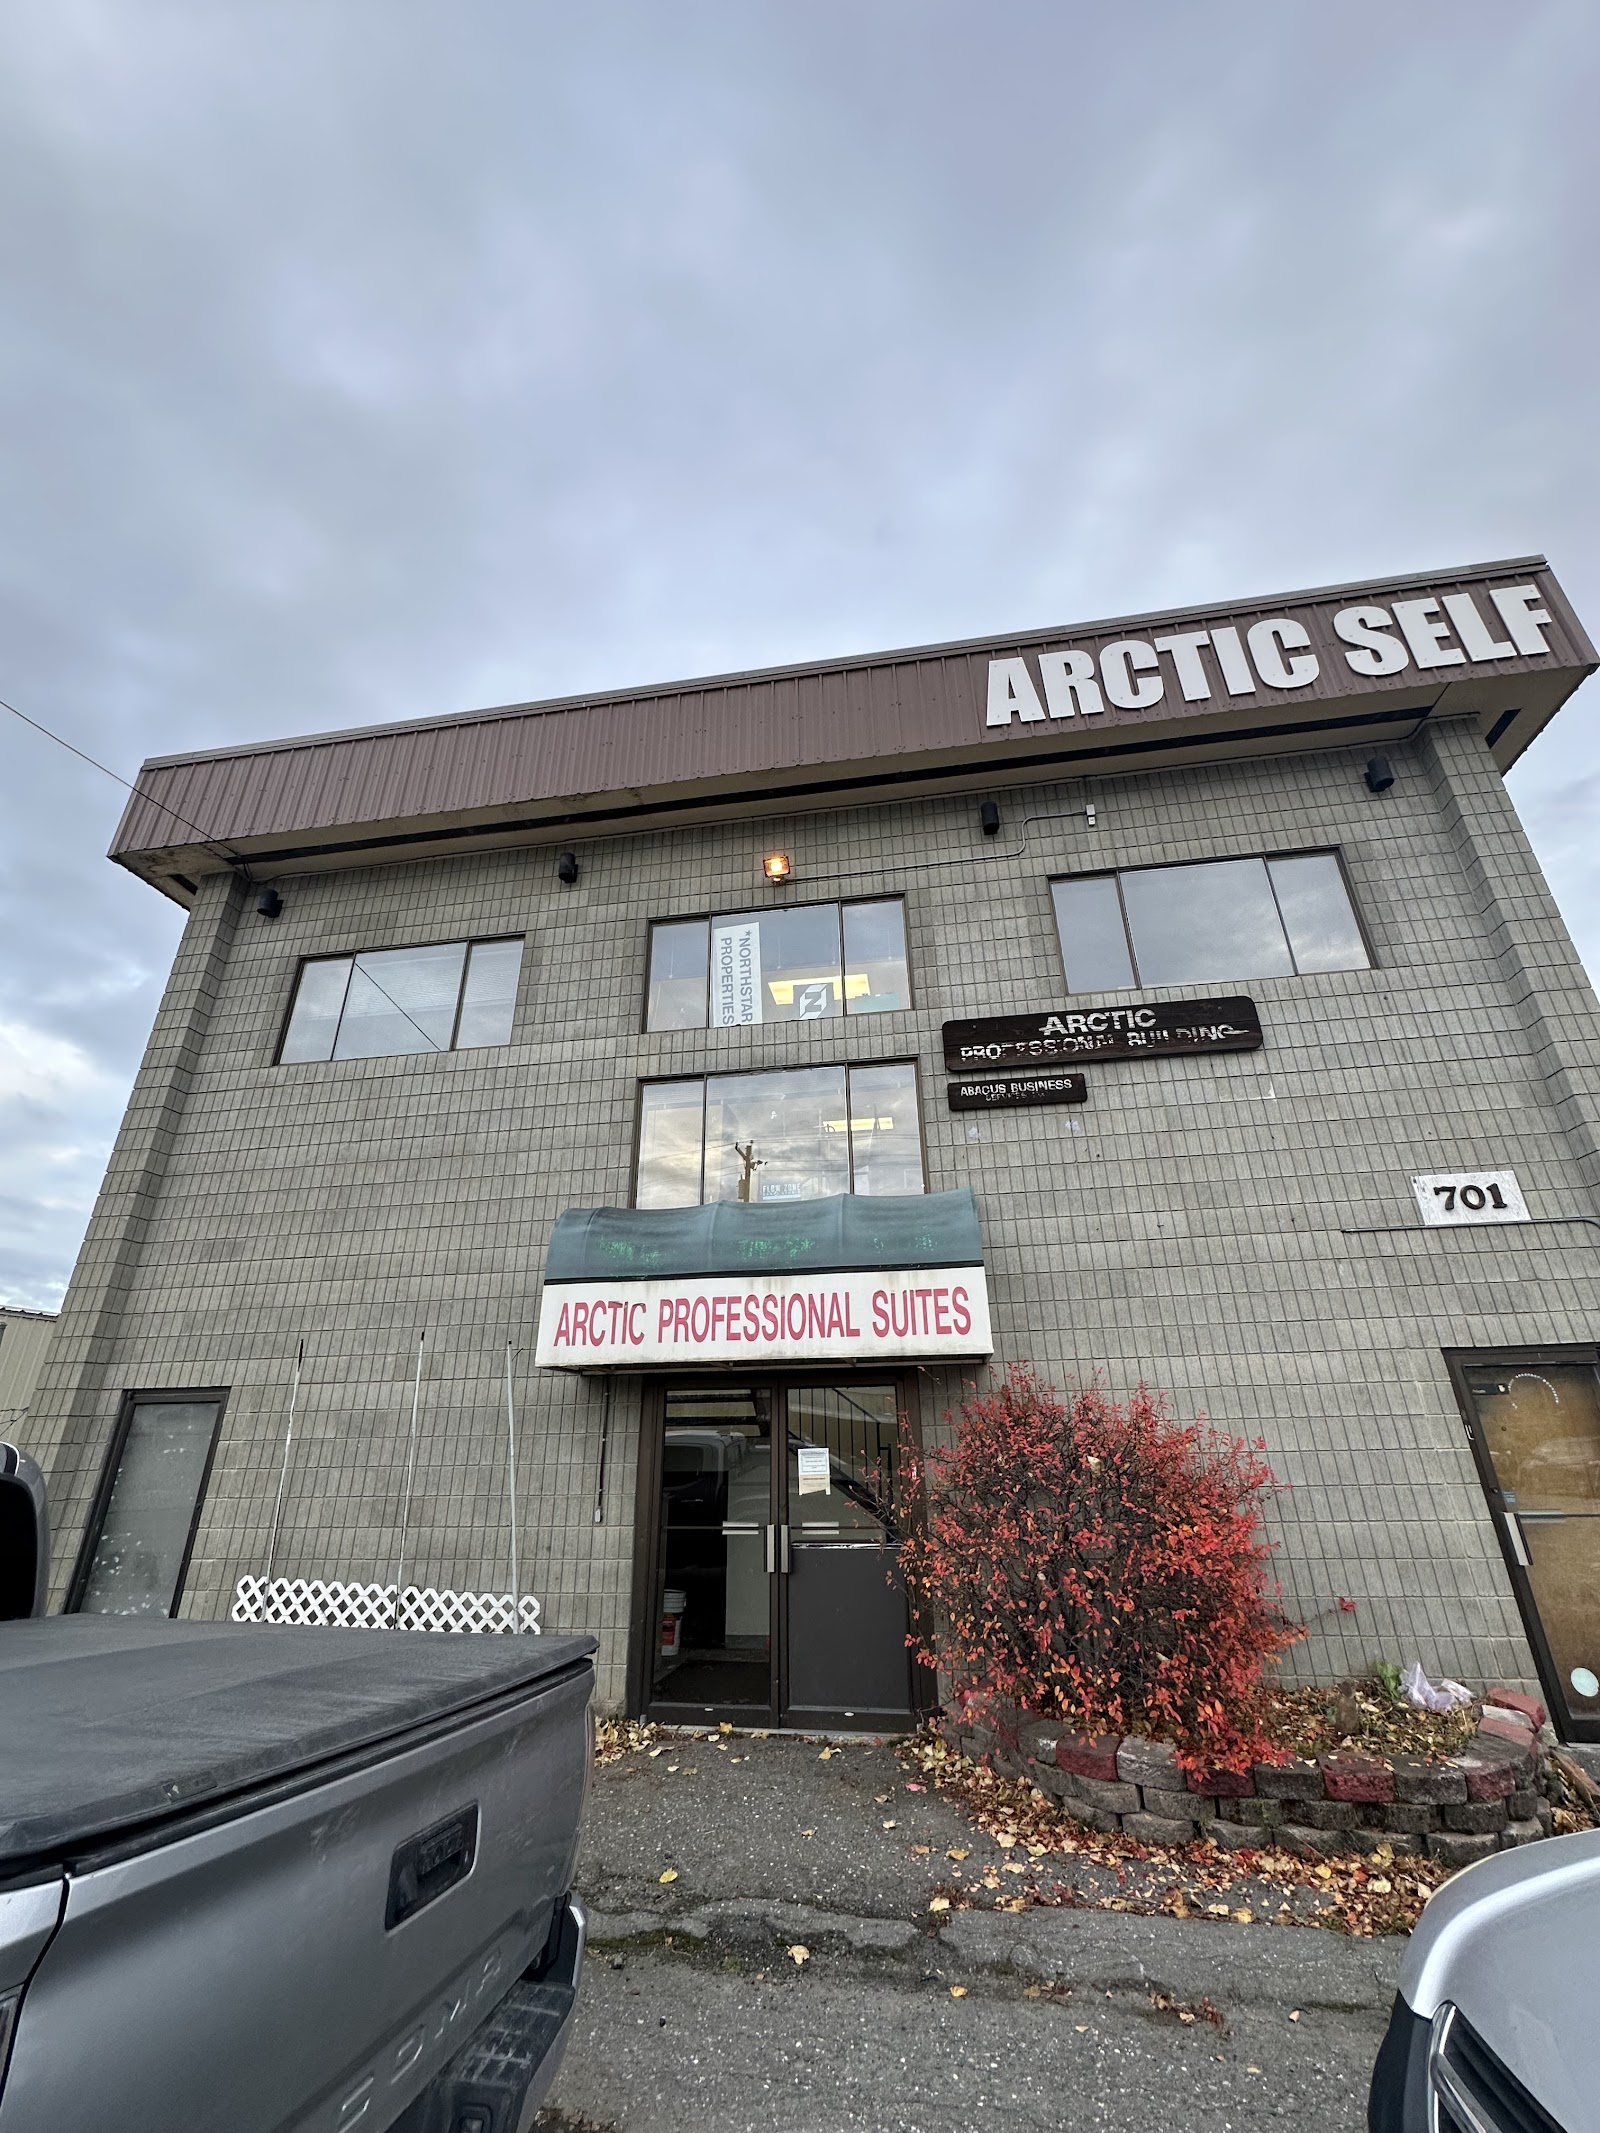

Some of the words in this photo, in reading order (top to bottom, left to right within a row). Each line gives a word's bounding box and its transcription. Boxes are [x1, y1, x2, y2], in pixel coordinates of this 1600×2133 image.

[986, 618, 1320, 727] ARCTIC
[1333, 584, 1553, 677] SELF
[720, 937, 734, 1025] PROPERTIES
[738, 937, 754, 1023] NORTHSTAR
[1039, 1008, 1158, 1036] ARCTIC
[960, 1084, 1006, 1097] ABACUS
[1010, 1079, 1073, 1093] BUSINESS
[762, 1184, 781, 1194] FLOW
[784, 1182, 801, 1191] ZONE
[1433, 1182, 1508, 1211] 701
[553, 1300, 646, 1347] ARCTIC
[657, 1290, 861, 1344] PROFESSIONAL
[871, 1285, 972, 1338] SUITES
